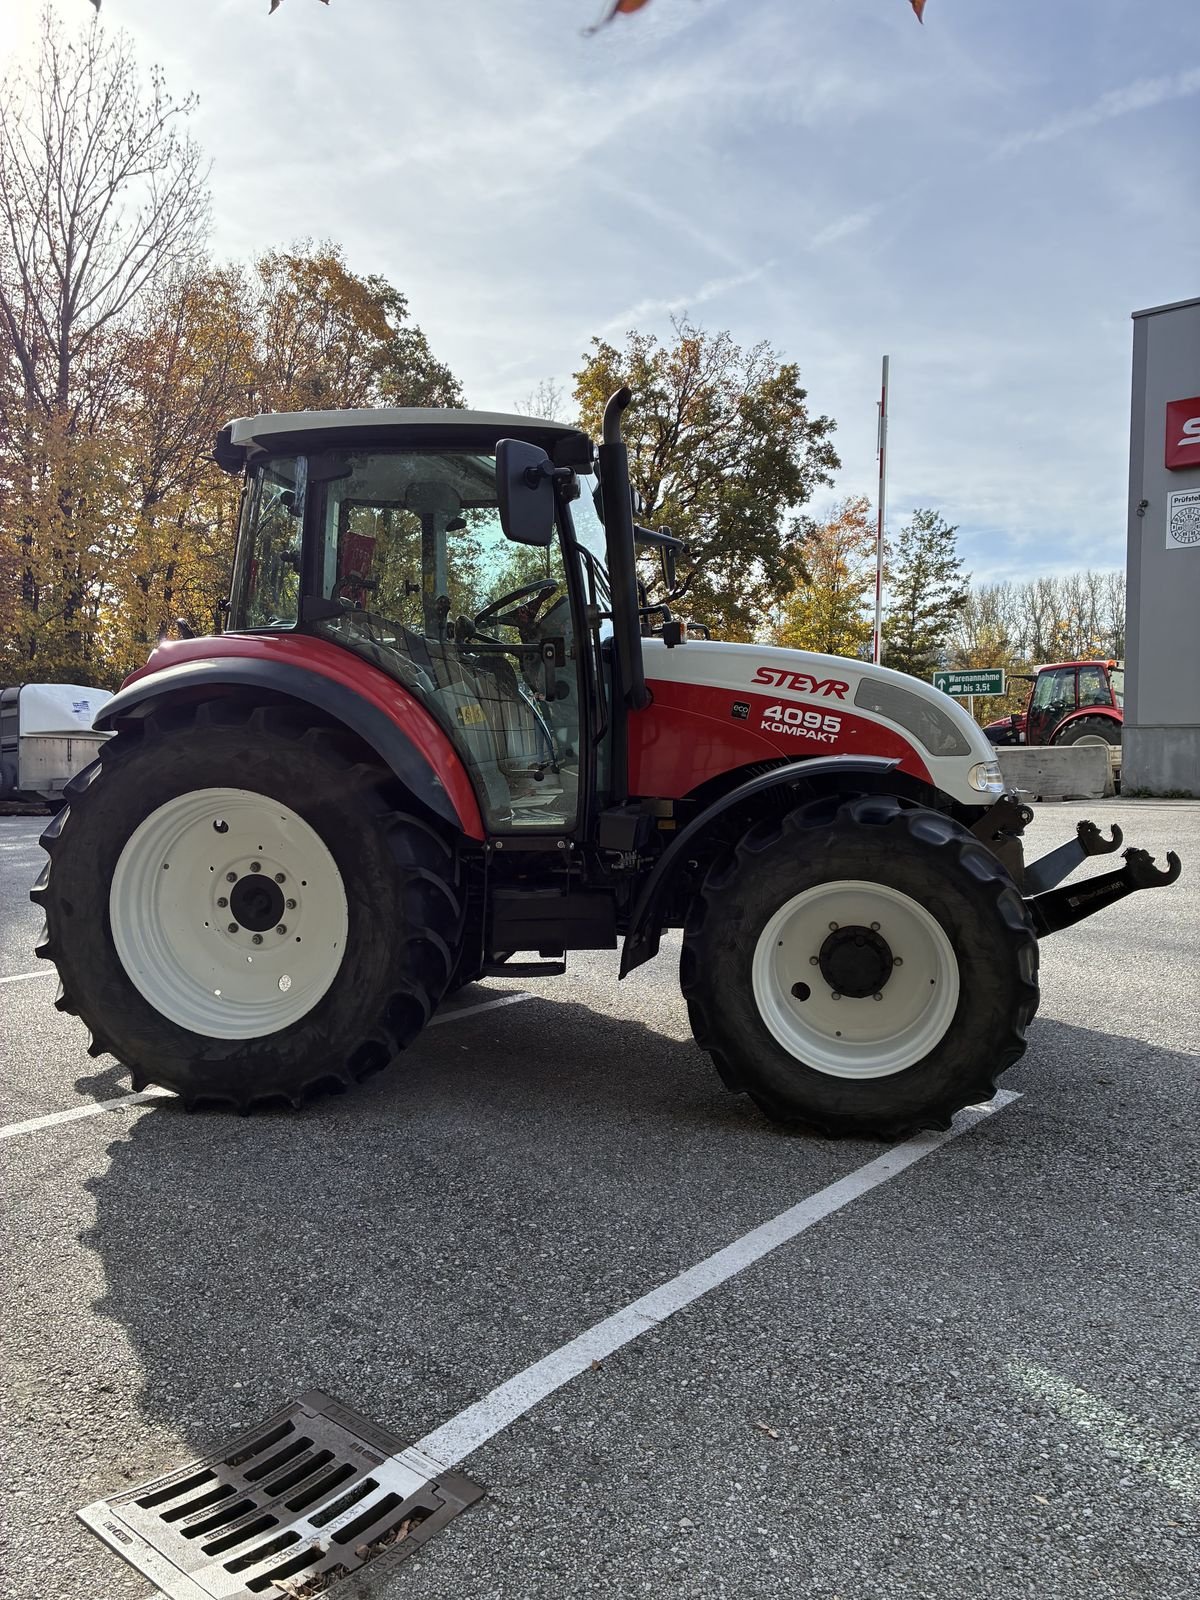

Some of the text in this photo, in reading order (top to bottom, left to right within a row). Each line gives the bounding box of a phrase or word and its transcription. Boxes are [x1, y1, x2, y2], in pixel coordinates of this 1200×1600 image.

[750, 666, 850, 700] STEYR
[948, 673, 1000, 683] Warenannahme
[963, 683, 990, 692] bis 3,5t
[763, 705, 842, 733] 4095
[760, 720, 838, 744] KOMPAKT
